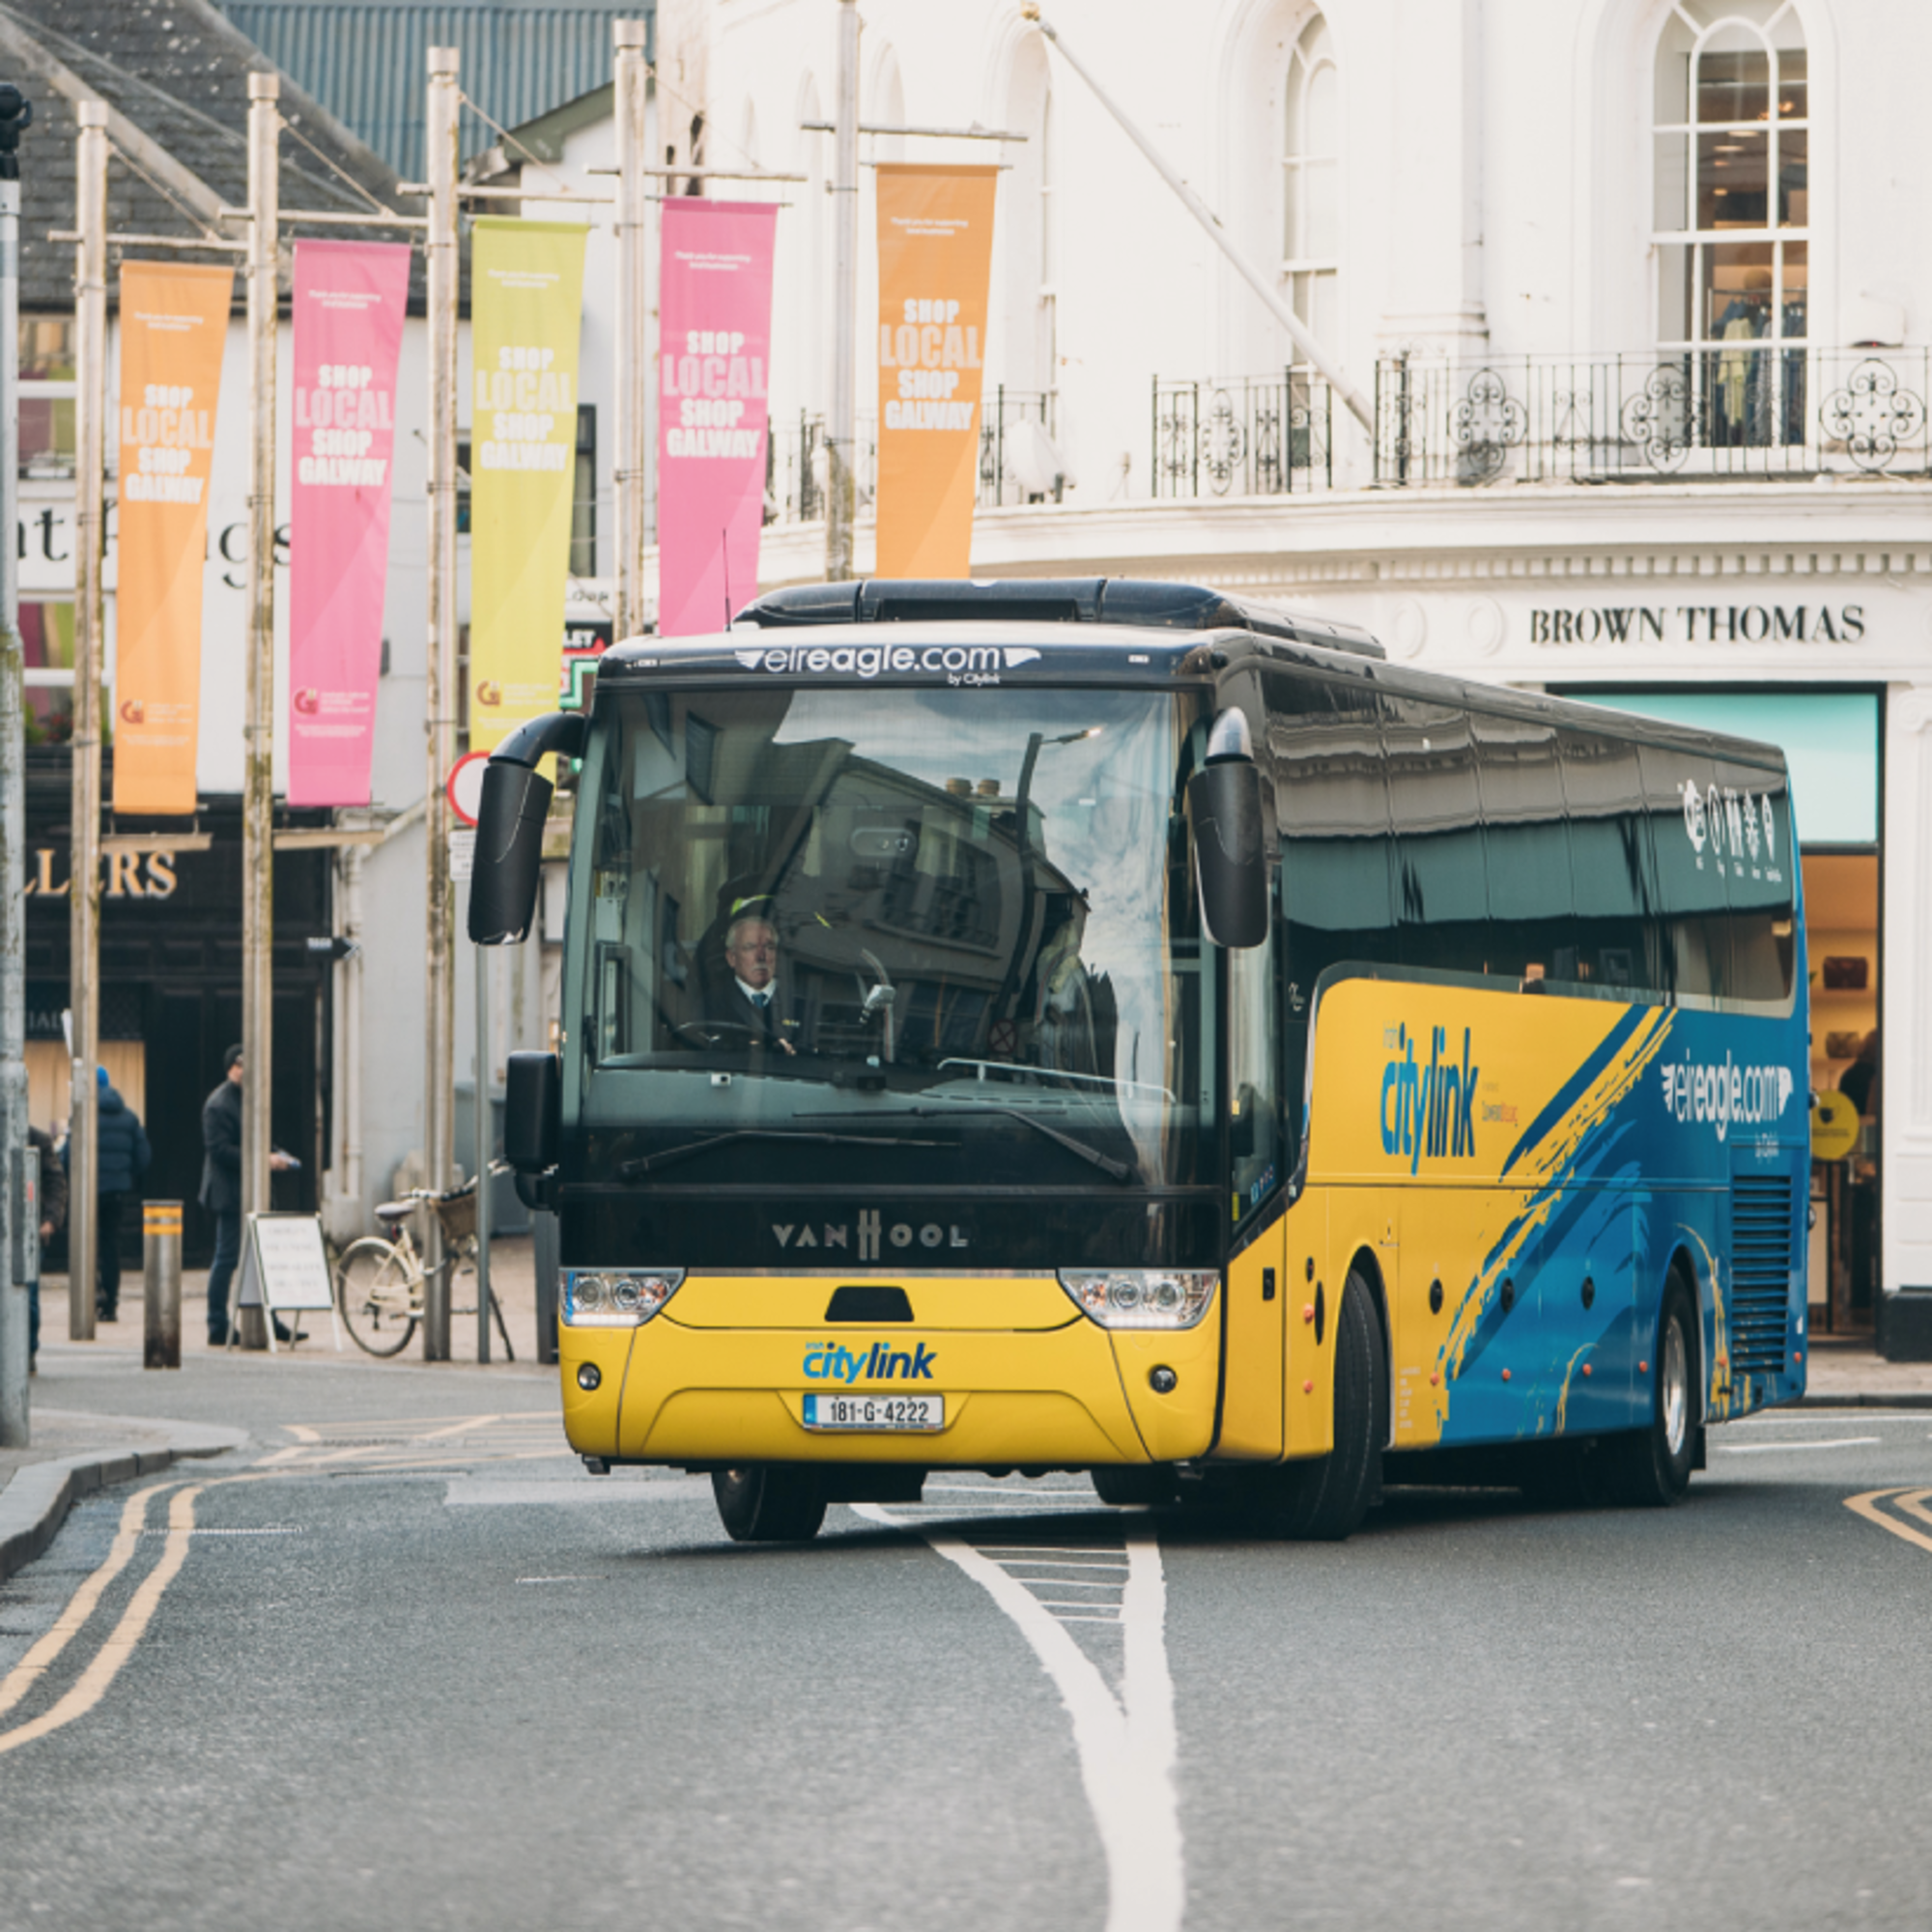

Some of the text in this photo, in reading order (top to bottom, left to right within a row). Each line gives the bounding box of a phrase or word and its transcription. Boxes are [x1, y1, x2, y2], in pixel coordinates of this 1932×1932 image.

[904, 298, 959, 324] SHOP
[687, 329, 744, 355] SHOP
[880, 324, 981, 369] LOCAL
[499, 346, 554, 371] SHOP
[319, 364, 372, 389] SHOP
[476, 369, 575, 412] LOCAL
[663, 354, 767, 398] LOCAL
[898, 369, 959, 399] SHOP
[145, 384, 193, 410] SHOP
[296, 386, 392, 430] LOCAL
[680, 397, 744, 428] SHOP
[122, 406, 212, 449] LOCAL
[493, 412, 554, 441] SHOP
[885, 399, 975, 430] GALWAY
[312, 427, 372, 456] SHOP
[480, 440, 568, 471] GALWAY
[667, 427, 761, 458] GALWAY
[138, 446, 191, 475] SHOP
[298, 456, 387, 486] GALWAY
[125, 473, 205, 504] GALWAY
[1530, 605, 1865, 644] BROWN THOMAS
[764, 645, 1001, 678] eireagle.com
[1380, 1022, 1479, 1178] citylink
[1674, 1047, 1777, 1143] eireagle.com
[803, 1341, 937, 1384] citylink
[830, 1401, 929, 1422] 181-G-4222
